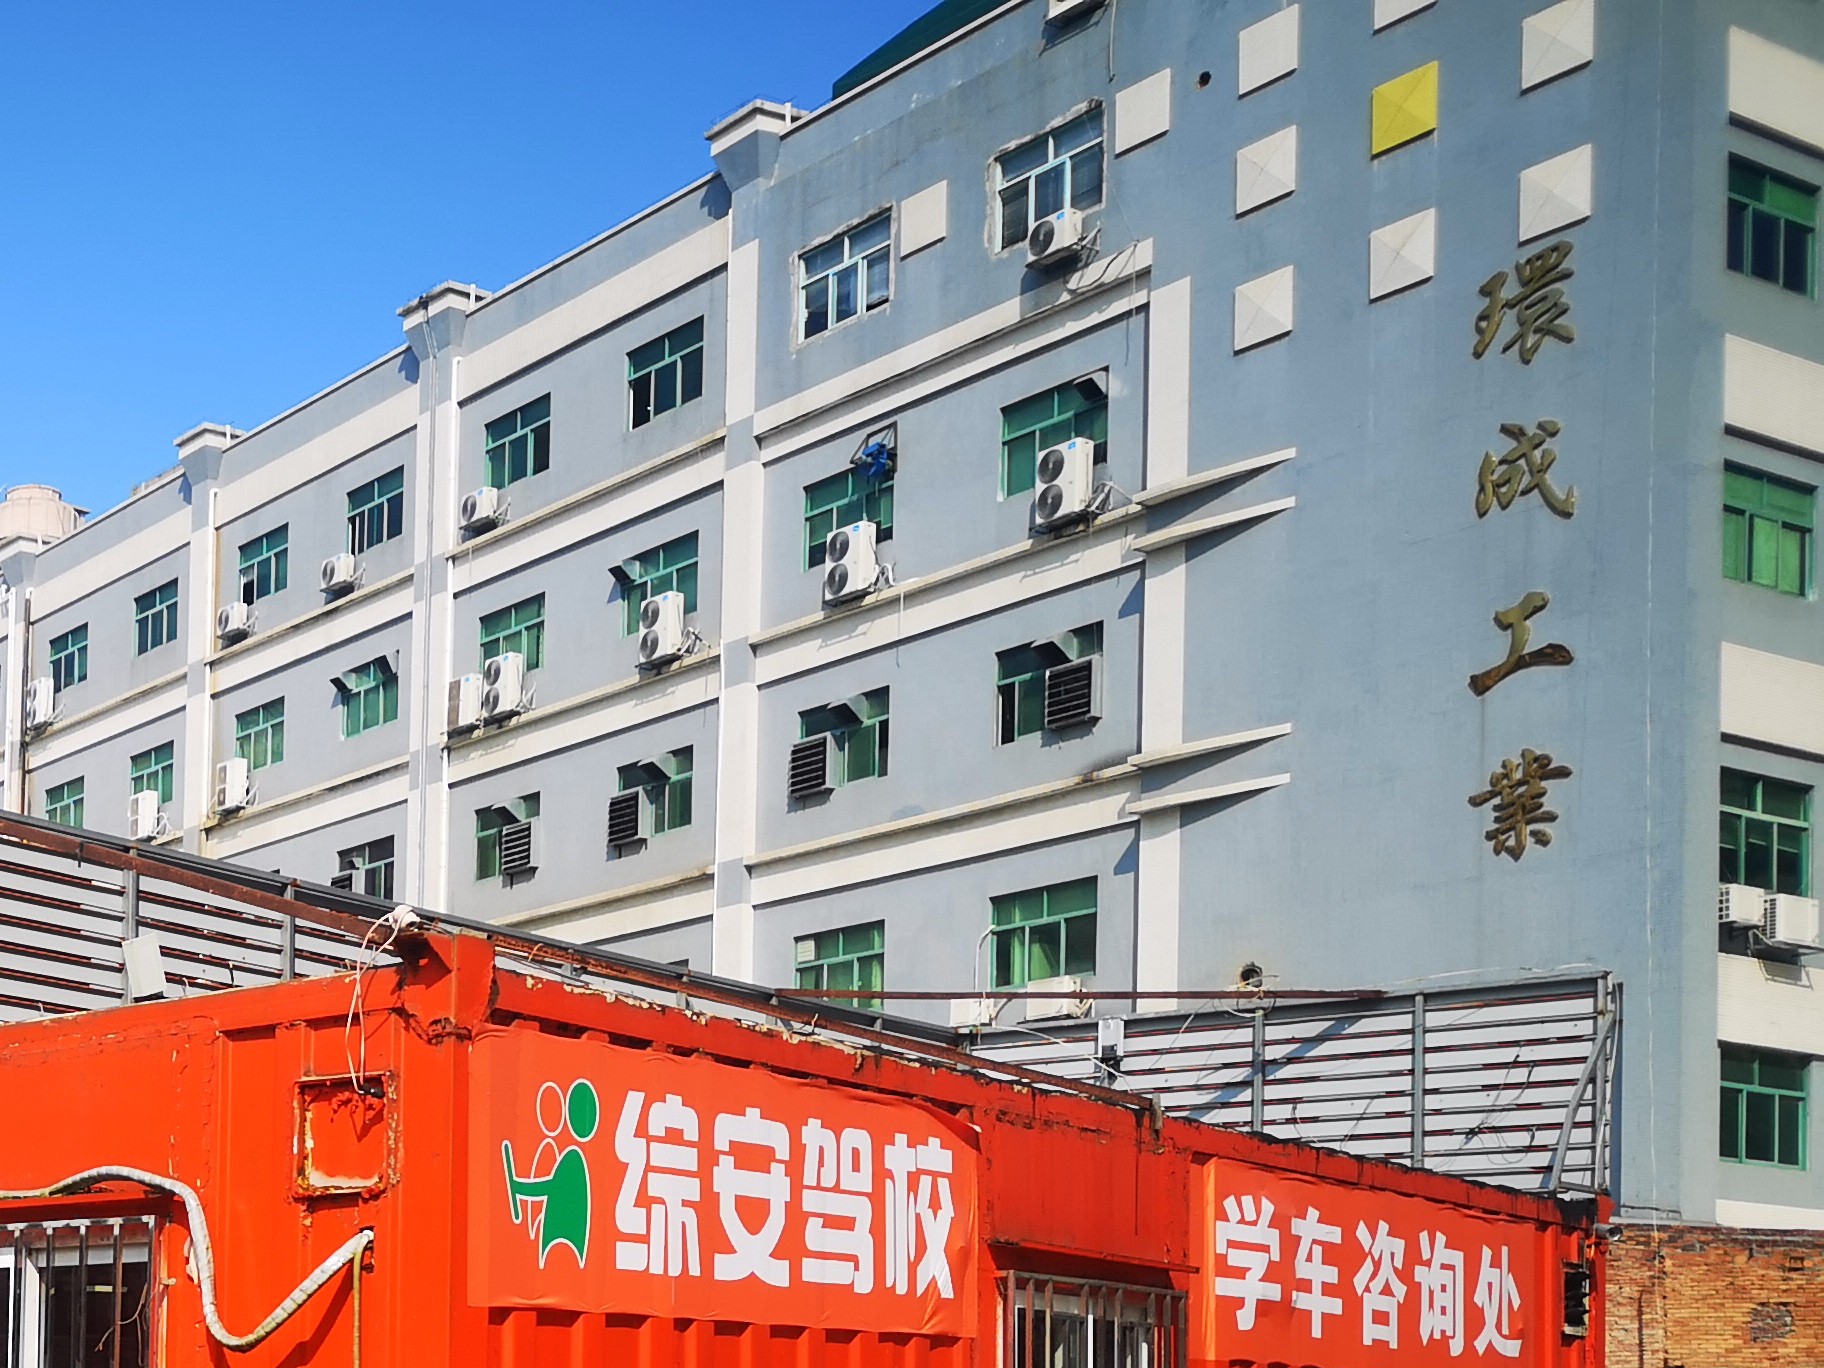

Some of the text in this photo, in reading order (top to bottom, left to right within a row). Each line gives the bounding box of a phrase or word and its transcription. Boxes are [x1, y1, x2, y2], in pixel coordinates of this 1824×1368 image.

[614, 1089, 954, 1299] 综安驾校
[1214, 1194, 1523, 1358] 学车咨询处
